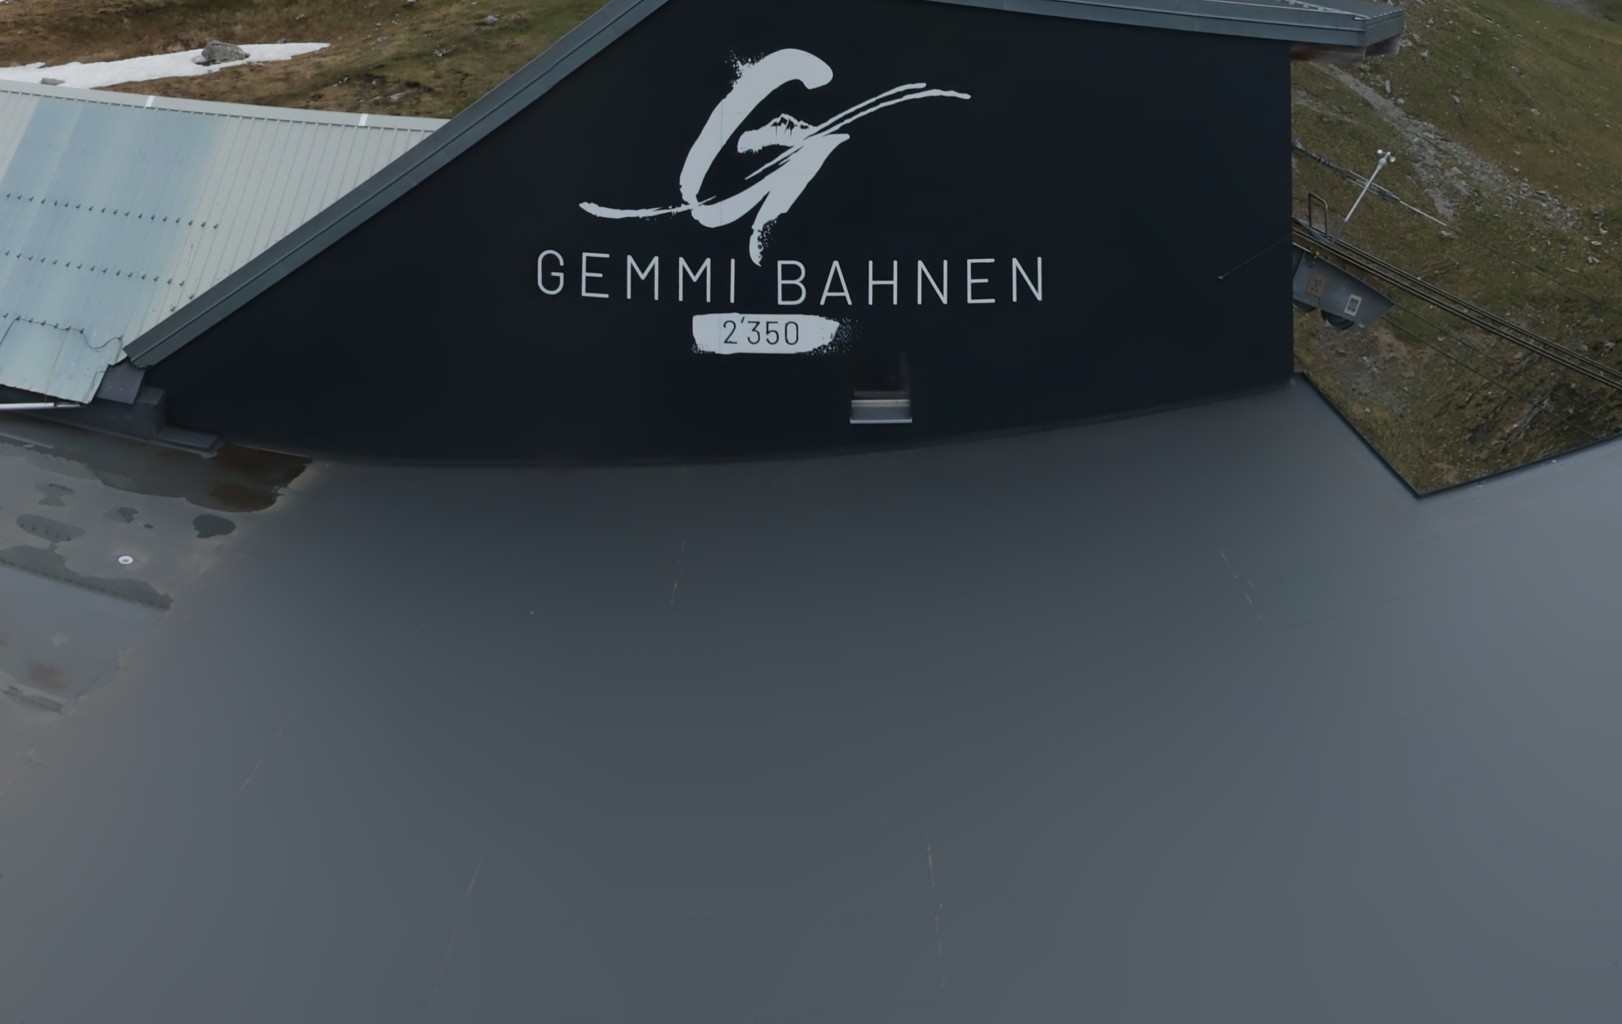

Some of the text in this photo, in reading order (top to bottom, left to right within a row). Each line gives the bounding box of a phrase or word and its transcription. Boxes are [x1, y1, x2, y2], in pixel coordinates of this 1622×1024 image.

[537, 249, 1044, 306] GEMMI BAHNEN
[722, 315, 800, 346] 2'350
